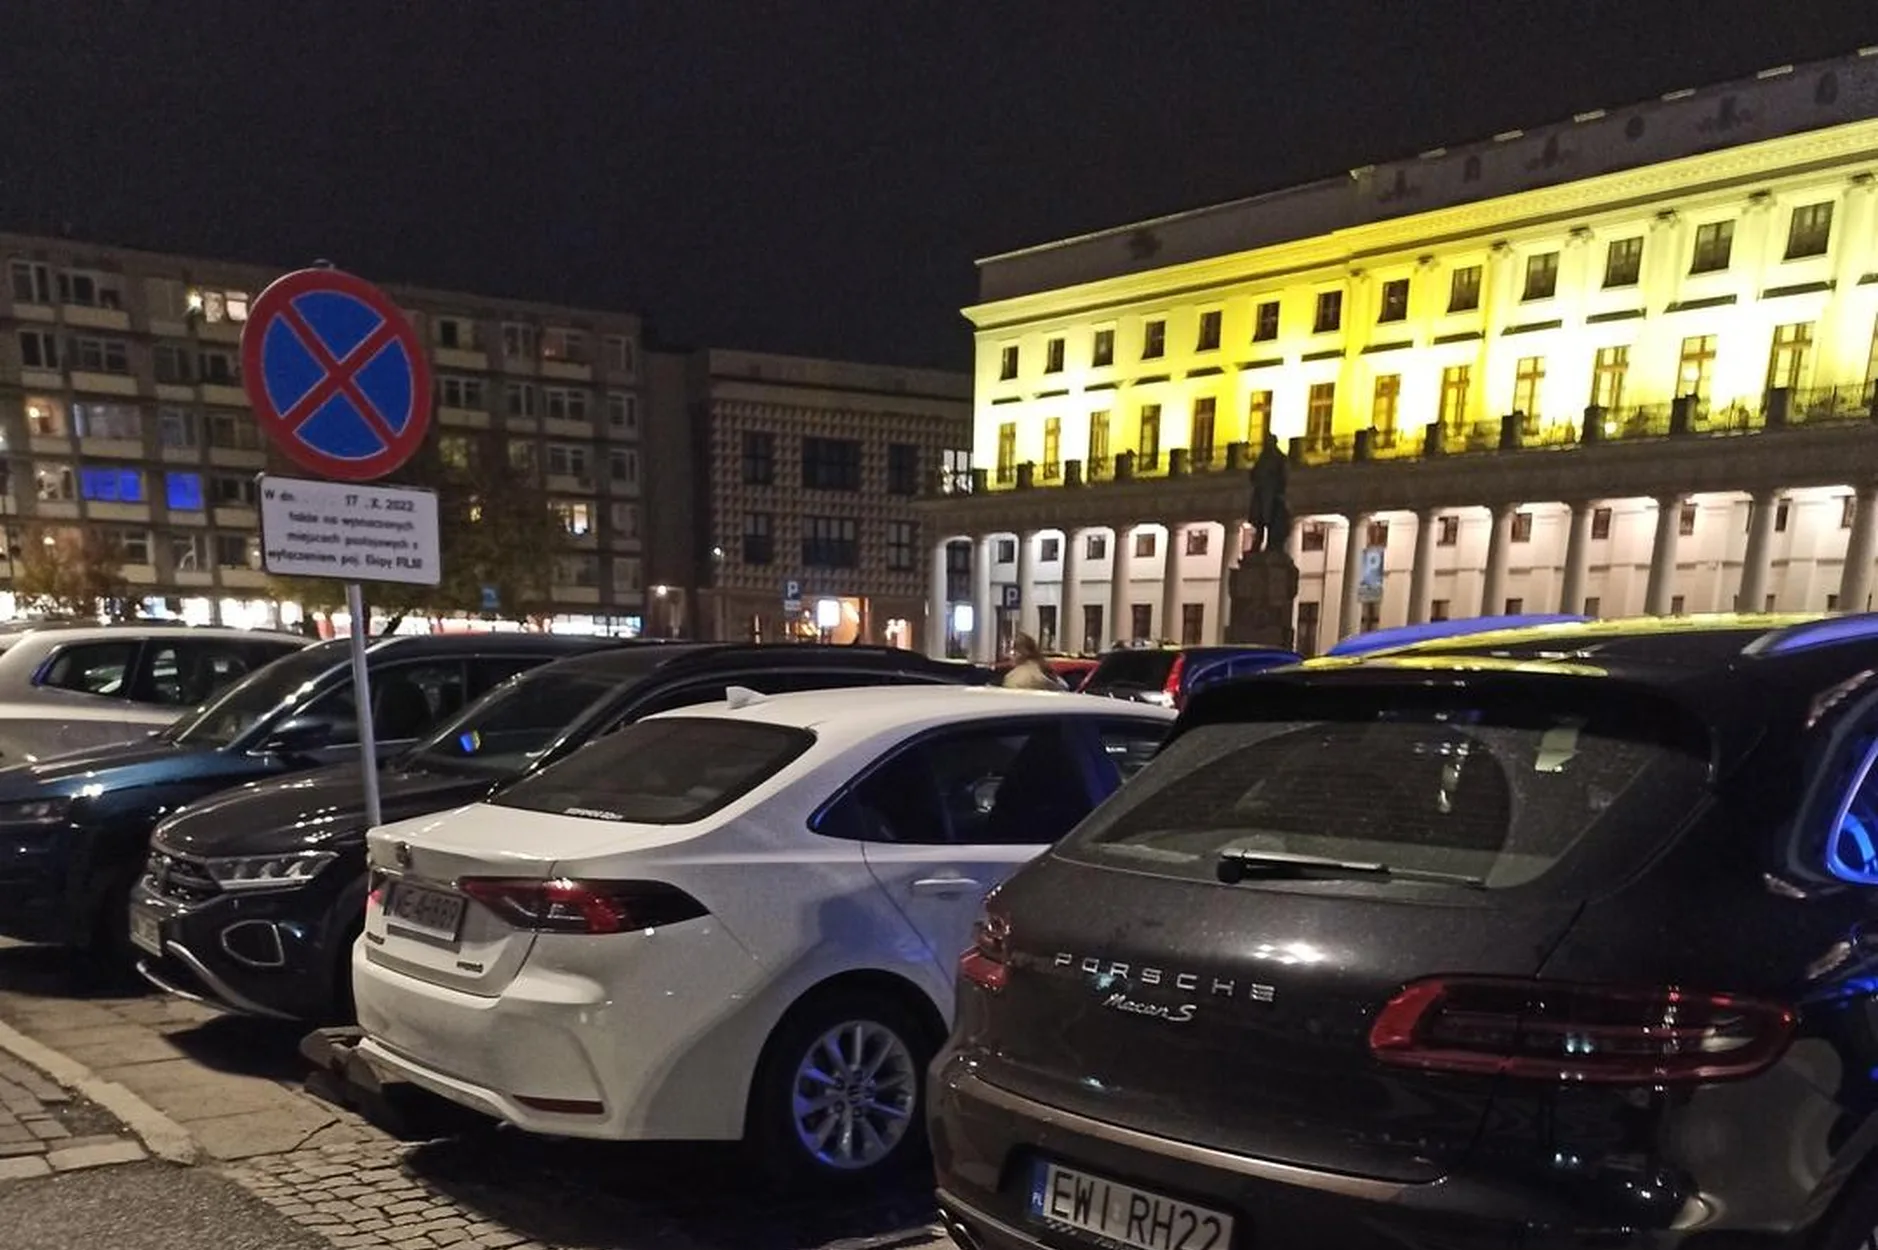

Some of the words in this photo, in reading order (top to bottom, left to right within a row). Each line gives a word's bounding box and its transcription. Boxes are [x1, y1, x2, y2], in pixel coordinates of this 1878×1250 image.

[264, 489, 276, 500] W
[344, 494, 359, 506] 17
[323, 516, 338, 525] na
[787, 581, 799, 598] P
[1006, 586, 1019, 607] P
[1054, 952, 1276, 1002] PORSCHE
[1101, 992, 1169, 1018] Macan
[1166, 1003, 1198, 1021] S
[1051, 1170, 1111, 1232] EWI
